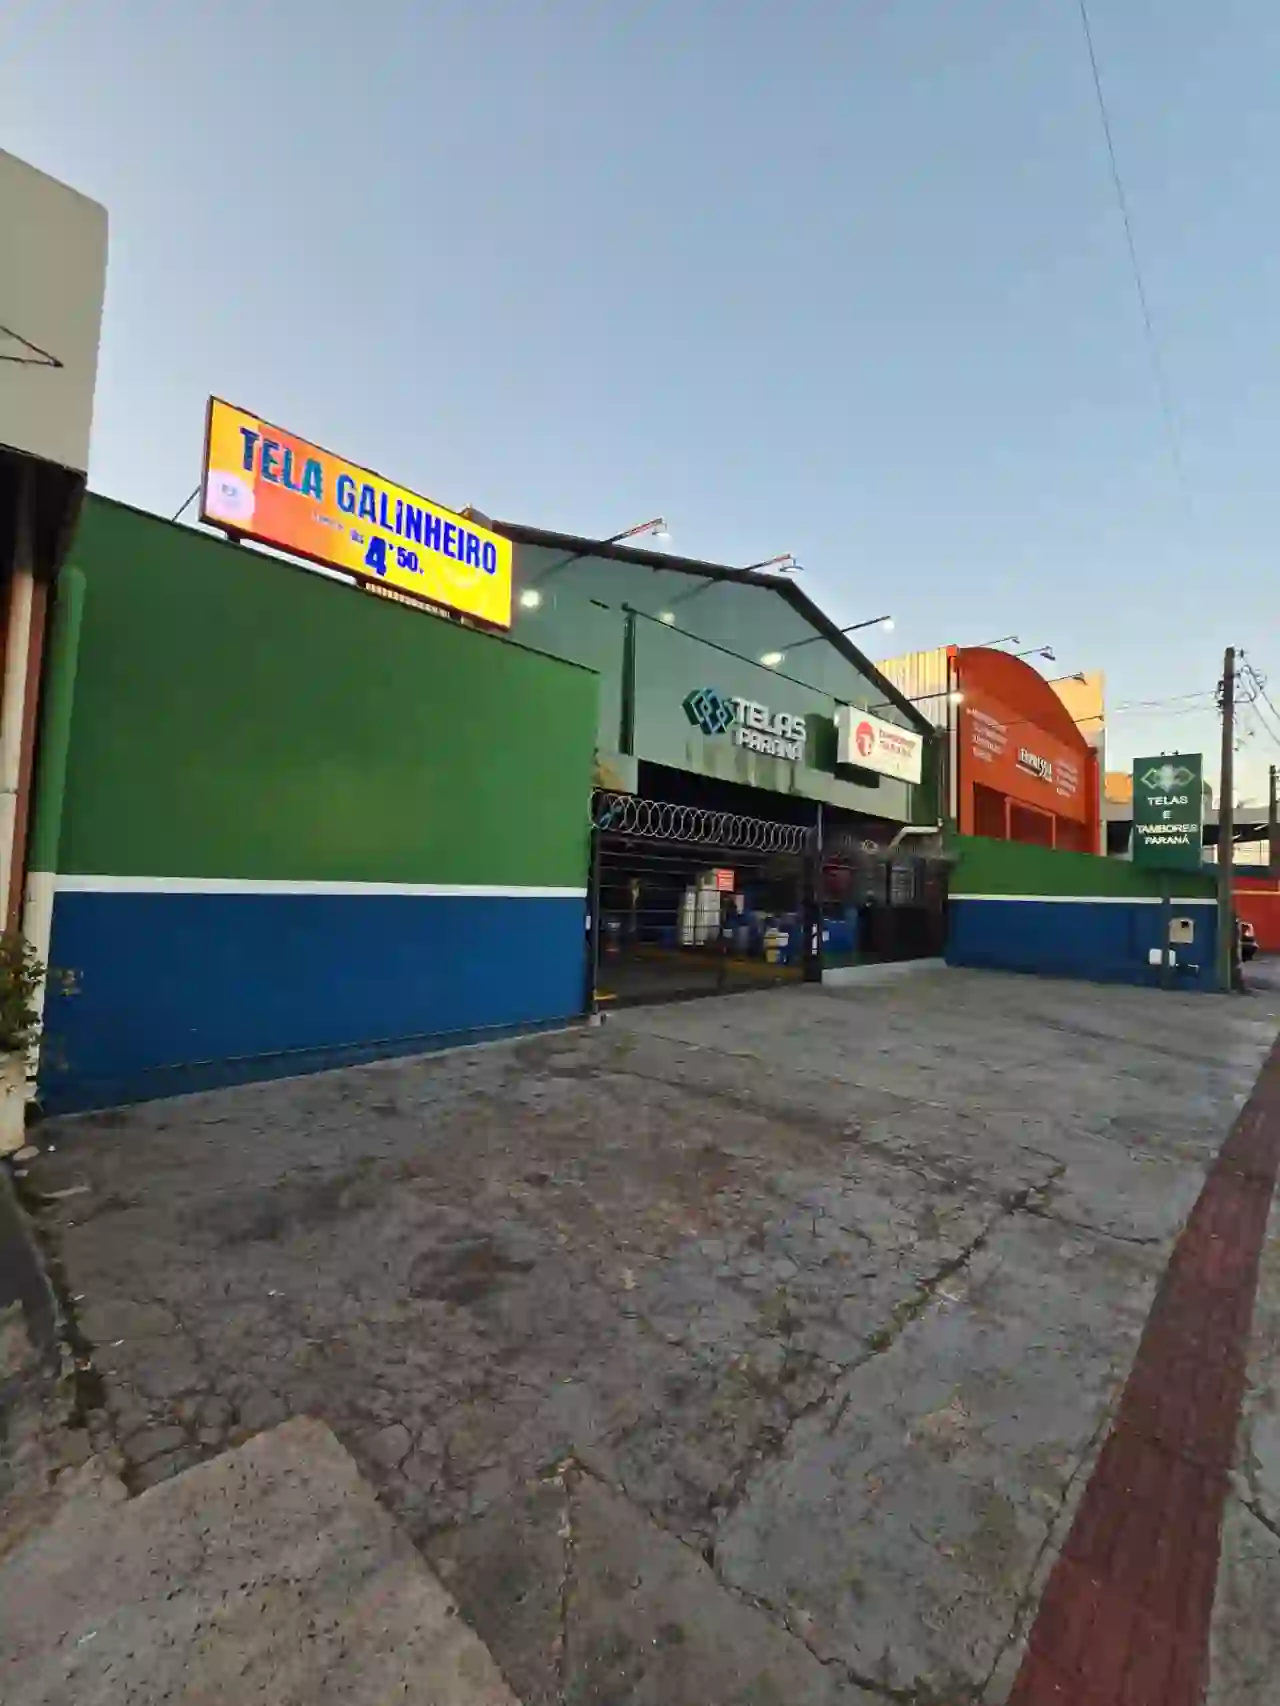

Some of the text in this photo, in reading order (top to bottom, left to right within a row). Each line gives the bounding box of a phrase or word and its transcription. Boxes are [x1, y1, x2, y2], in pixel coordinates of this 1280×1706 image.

[239, 427, 497, 575] TELA GALINHEIRO
[731, 697, 806, 741] TELAS
[1147, 795, 1188, 806] TELAS
[1162, 810, 1172, 819] E
[1136, 824, 1199, 834] TAMBORES
[1144, 834, 1190, 845] PARANÁ
